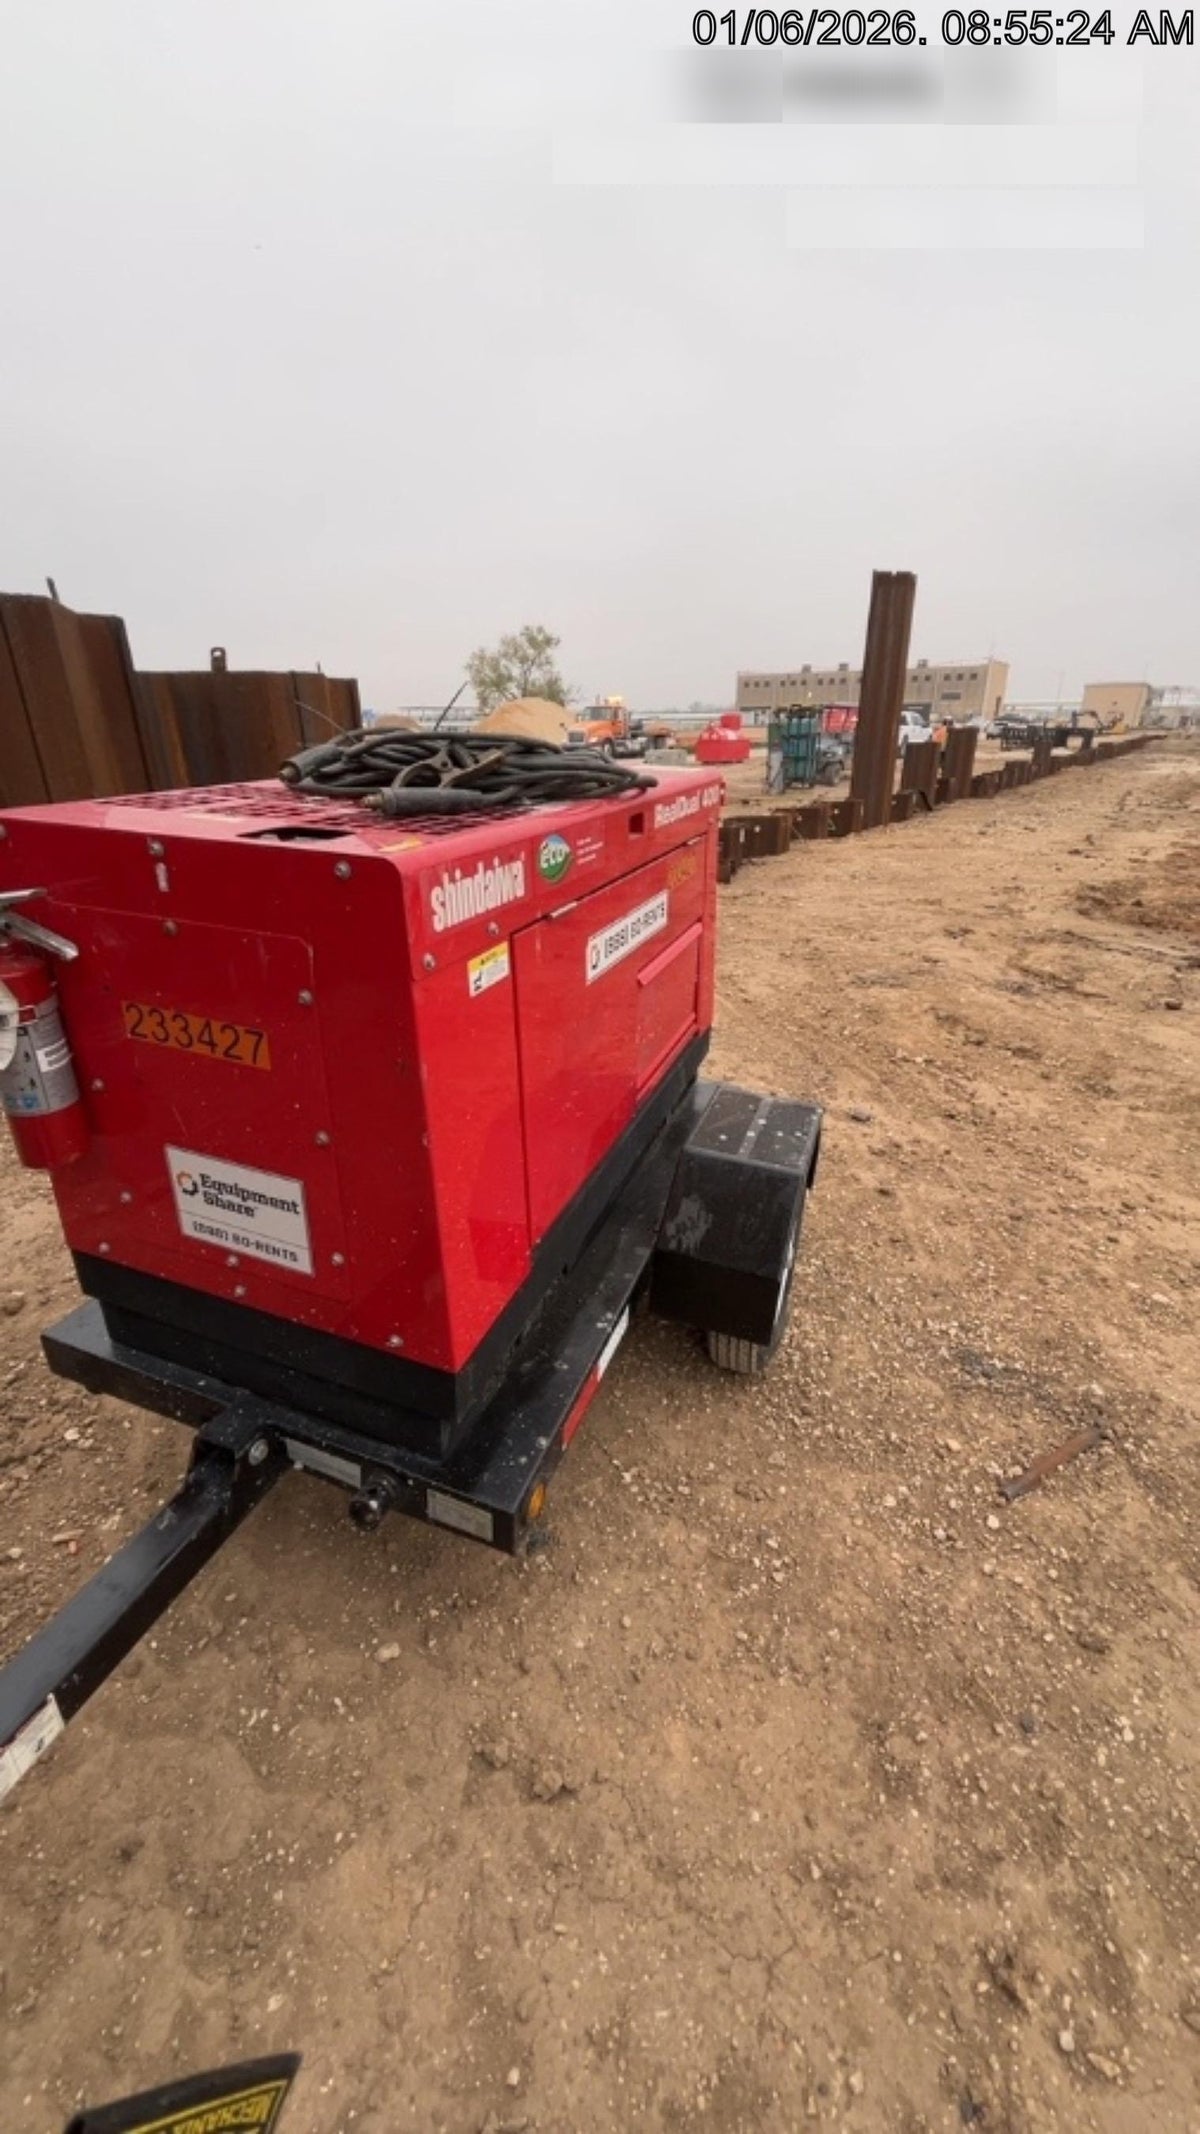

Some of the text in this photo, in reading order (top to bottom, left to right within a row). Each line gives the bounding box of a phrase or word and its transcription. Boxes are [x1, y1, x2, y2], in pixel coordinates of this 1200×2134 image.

[431, 855, 525, 933] shindaiwa
[125, 1003, 264, 1065] 233427
[199, 1173, 300, 1214] Equipment
[203, 1190, 255, 1217] Share
